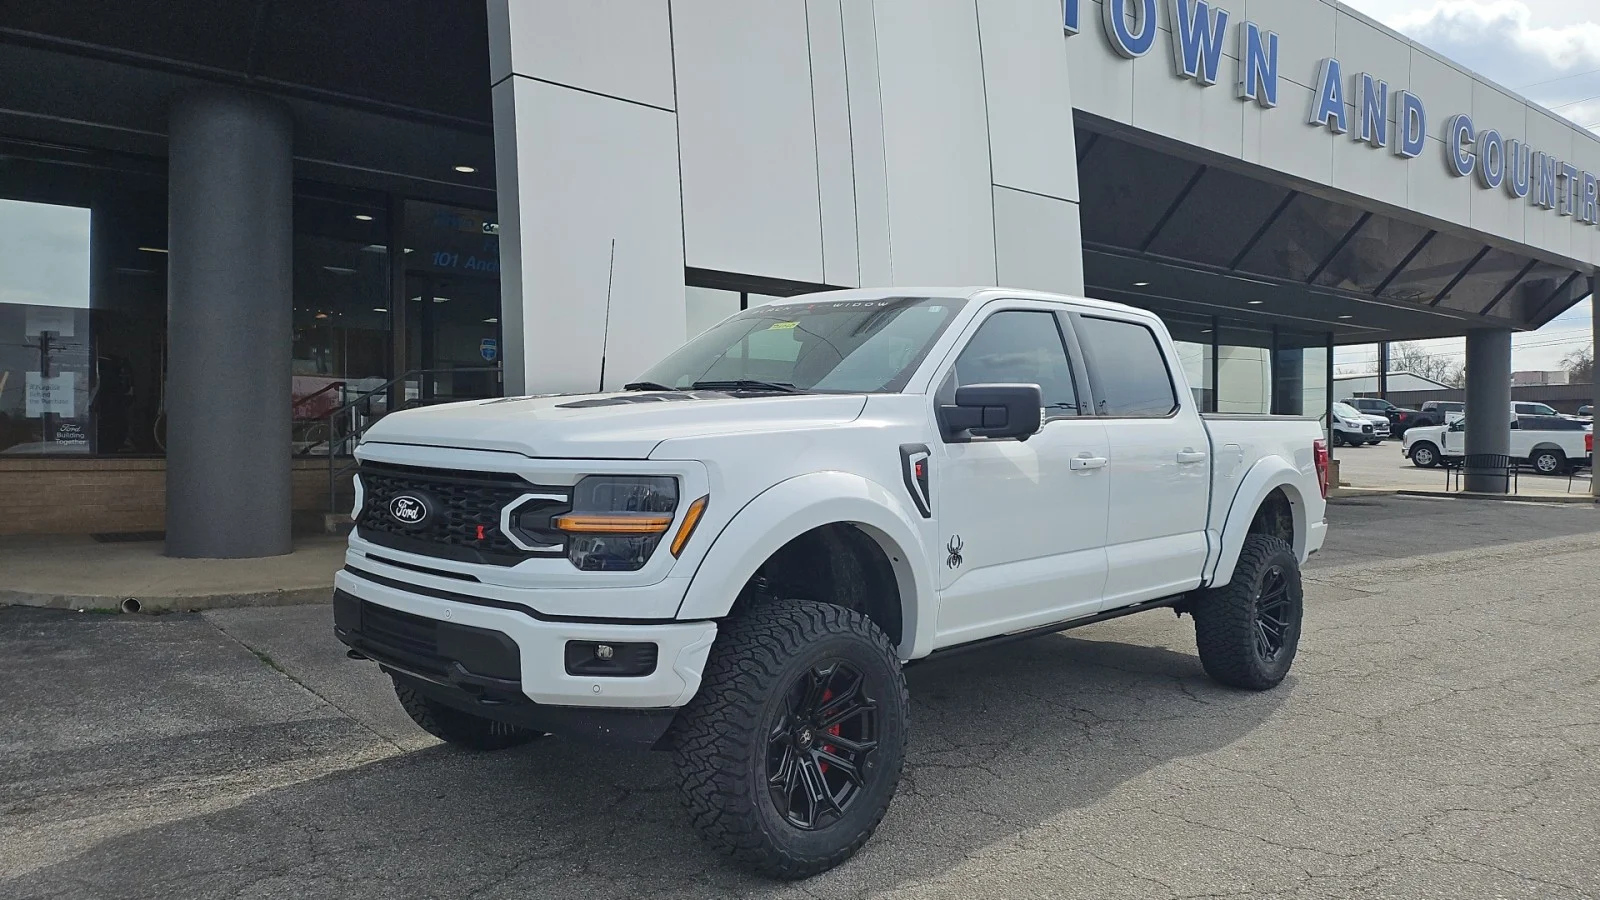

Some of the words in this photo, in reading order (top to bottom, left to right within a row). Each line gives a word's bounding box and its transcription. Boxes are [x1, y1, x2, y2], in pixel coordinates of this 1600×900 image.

[1309, 57, 1427, 159] AND
[1446, 113, 1600, 227] COUNTR
[432, 251, 459, 268] 101
[56, 431, 85, 439] Building
[60, 423, 81, 432] Ford
[394, 498, 420, 520] Ford
